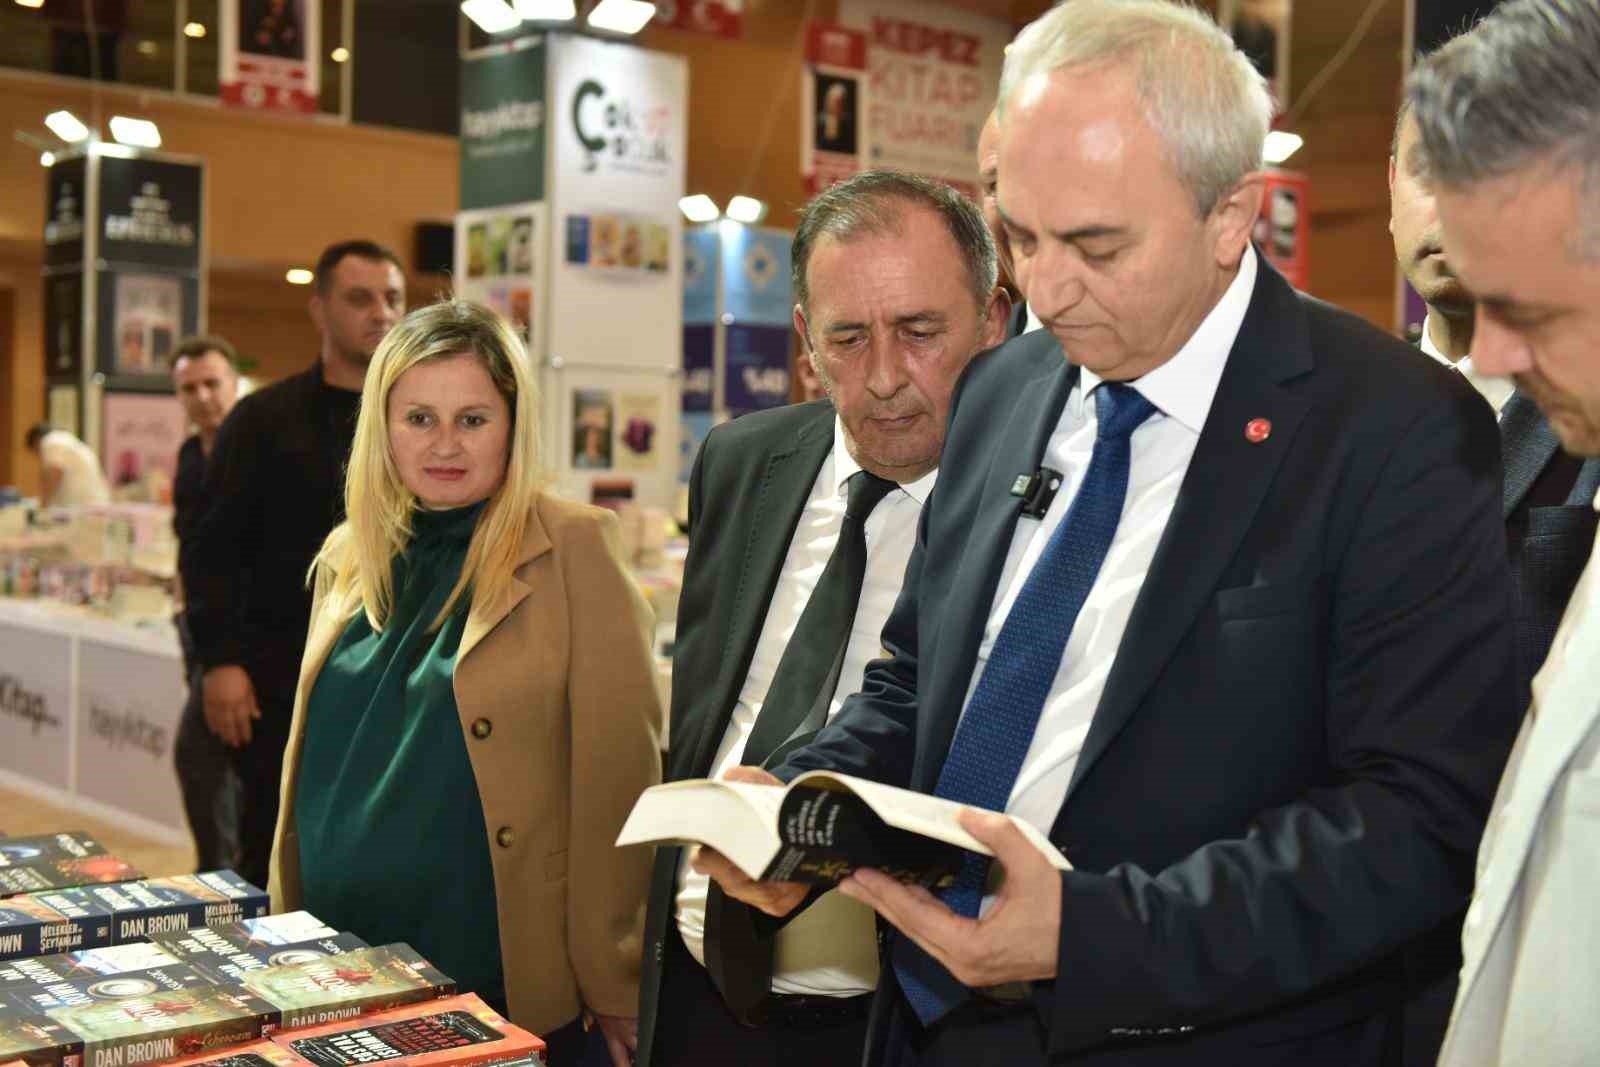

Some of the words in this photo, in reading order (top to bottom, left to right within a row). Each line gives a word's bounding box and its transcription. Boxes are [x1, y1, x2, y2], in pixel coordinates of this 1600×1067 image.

[872, 18, 981, 65] KEPEZ
[121, 918, 145, 938] DAN
[148, 912, 188, 936] BROWN
[95, 1048, 123, 1067] DAN
[126, 1037, 175, 1064] BROWN
[328, 1034, 380, 1062] SOSYAL
